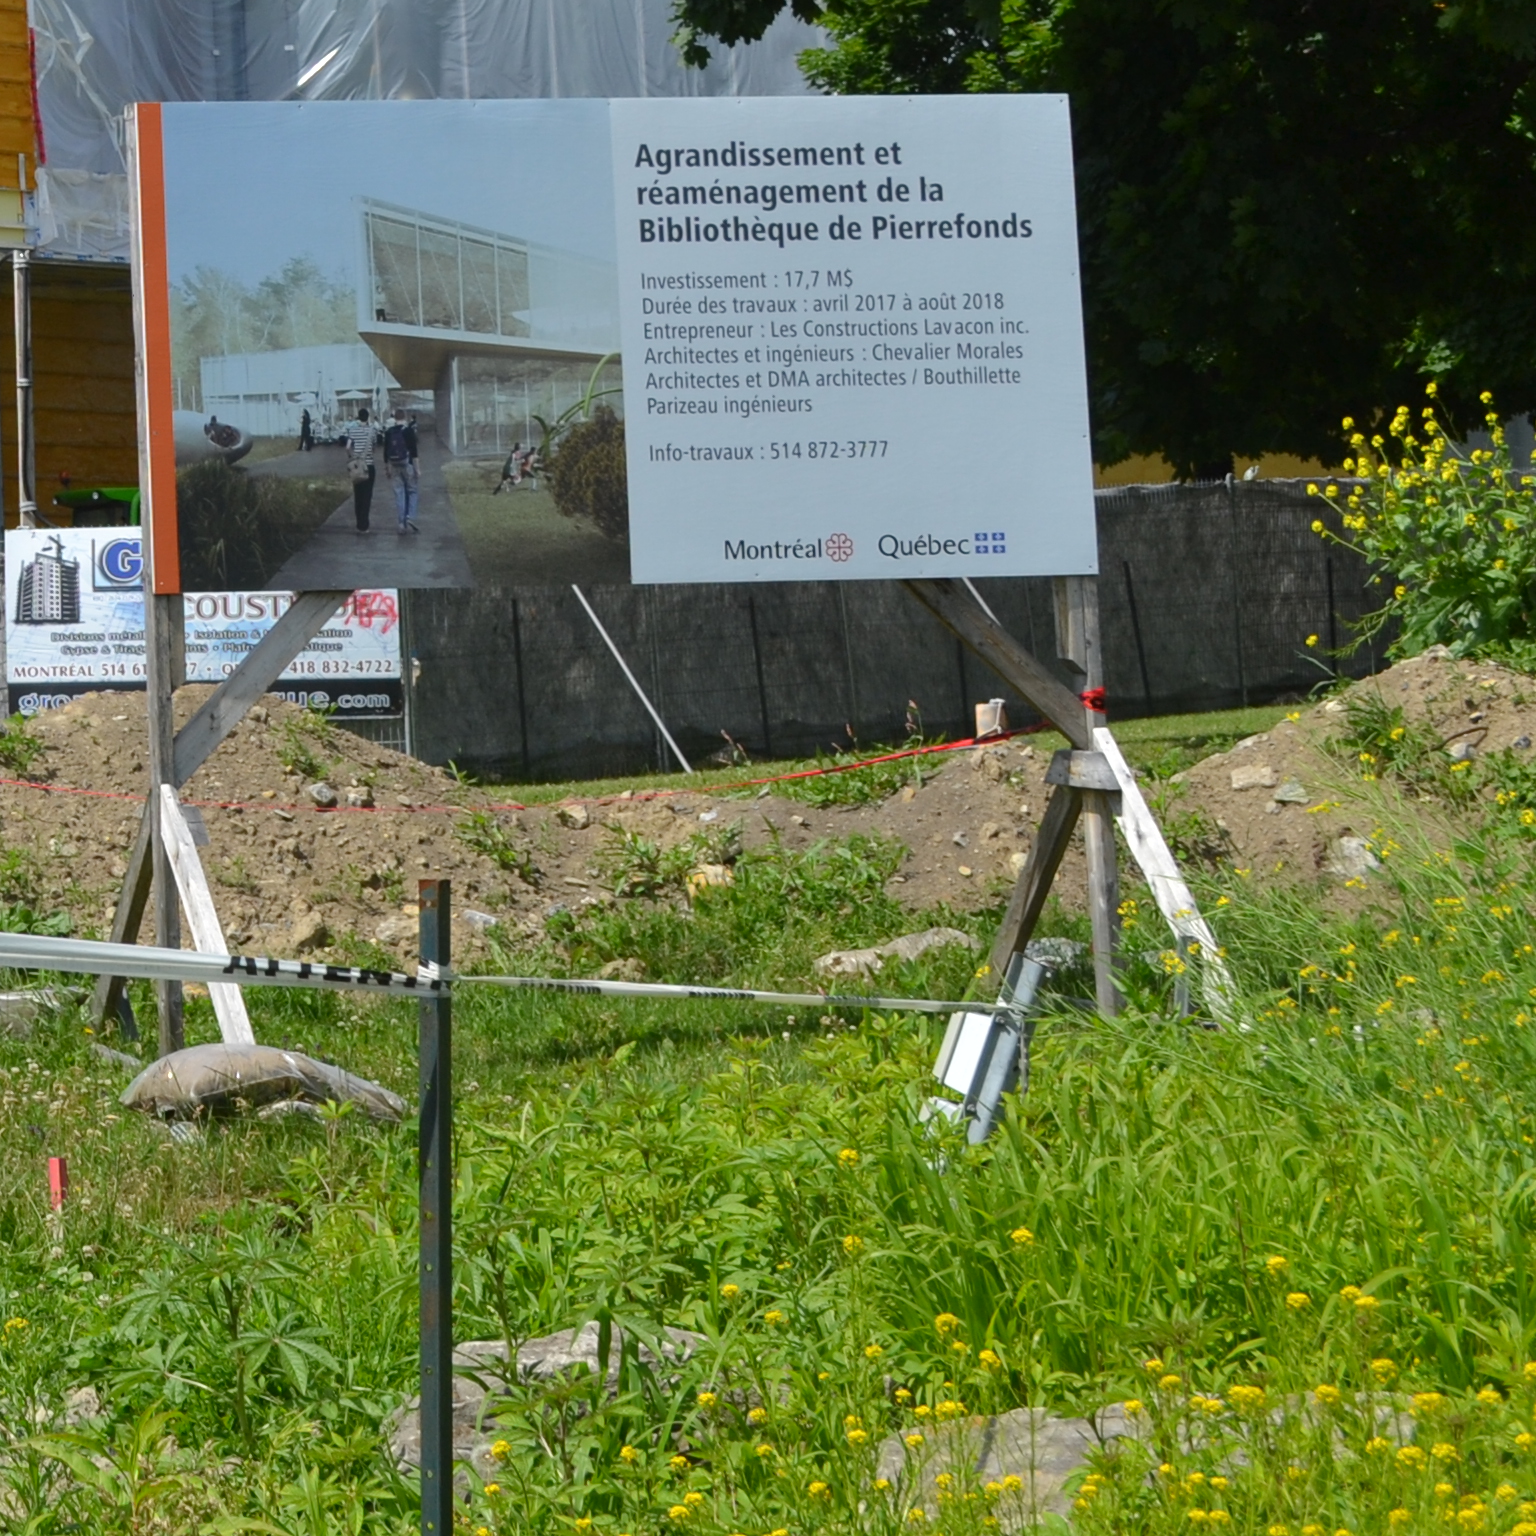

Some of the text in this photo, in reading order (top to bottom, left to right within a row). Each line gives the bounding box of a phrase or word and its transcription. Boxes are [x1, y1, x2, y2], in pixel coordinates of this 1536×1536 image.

[635, 141, 902, 175] Agrandissement et
[637, 176, 943, 211] réaménagement de la
[639, 212, 1033, 248] Bibliothèque de Pierrefonds
[641, 271, 767, 290] Investissement
[785, 270, 820, 290] 17,7
[827, 268, 853, 289] M$
[642, 296, 692, 315] Durée
[697, 296, 727, 313] des
[733, 297, 797, 313] travaux
[813, 294, 848, 312] avril
[855, 294, 896, 312] 2017
[902, 292, 912, 311] à
[918, 292, 956, 311] août
[962, 292, 1004, 310] 2018
[644, 322, 753, 343] Entrepreneur
[771, 321, 797, 338] Les
[803, 318, 918, 337] Constructions
[924, 318, 994, 336] Lavacon
[1000, 317, 1029, 335] inc.
[645, 346, 738, 365] Architectes
[744, 347, 760, 363] et
[766, 344, 854, 367] ingénieurs
[872, 341, 950, 361] Chevalier
[957, 341, 1023, 360] Morales
[646, 371, 740, 390] Architectes
[746, 372, 762, 388] et
[768, 370, 810, 387] DMA
[816, 368, 906, 387] architectes
[924, 366, 1021, 385] Bouthillette
[647, 395, 813, 418] Parizeau ingénieurs
[649, 443, 754, 462] Info-travaux
[771, 442, 801, 460] 514
[808, 440, 888, 459] 872-3777
[724, 533, 970, 561] Montréal Québec
[50, 632, 106, 642] Divisions
[60, 645, 98, 656] Gypse
[13, 663, 94, 678] MONTRÉAL
[101, 663, 125, 676] 514
[289, 661, 315, 674] 418
[322, 659, 392, 673] 832-4722
